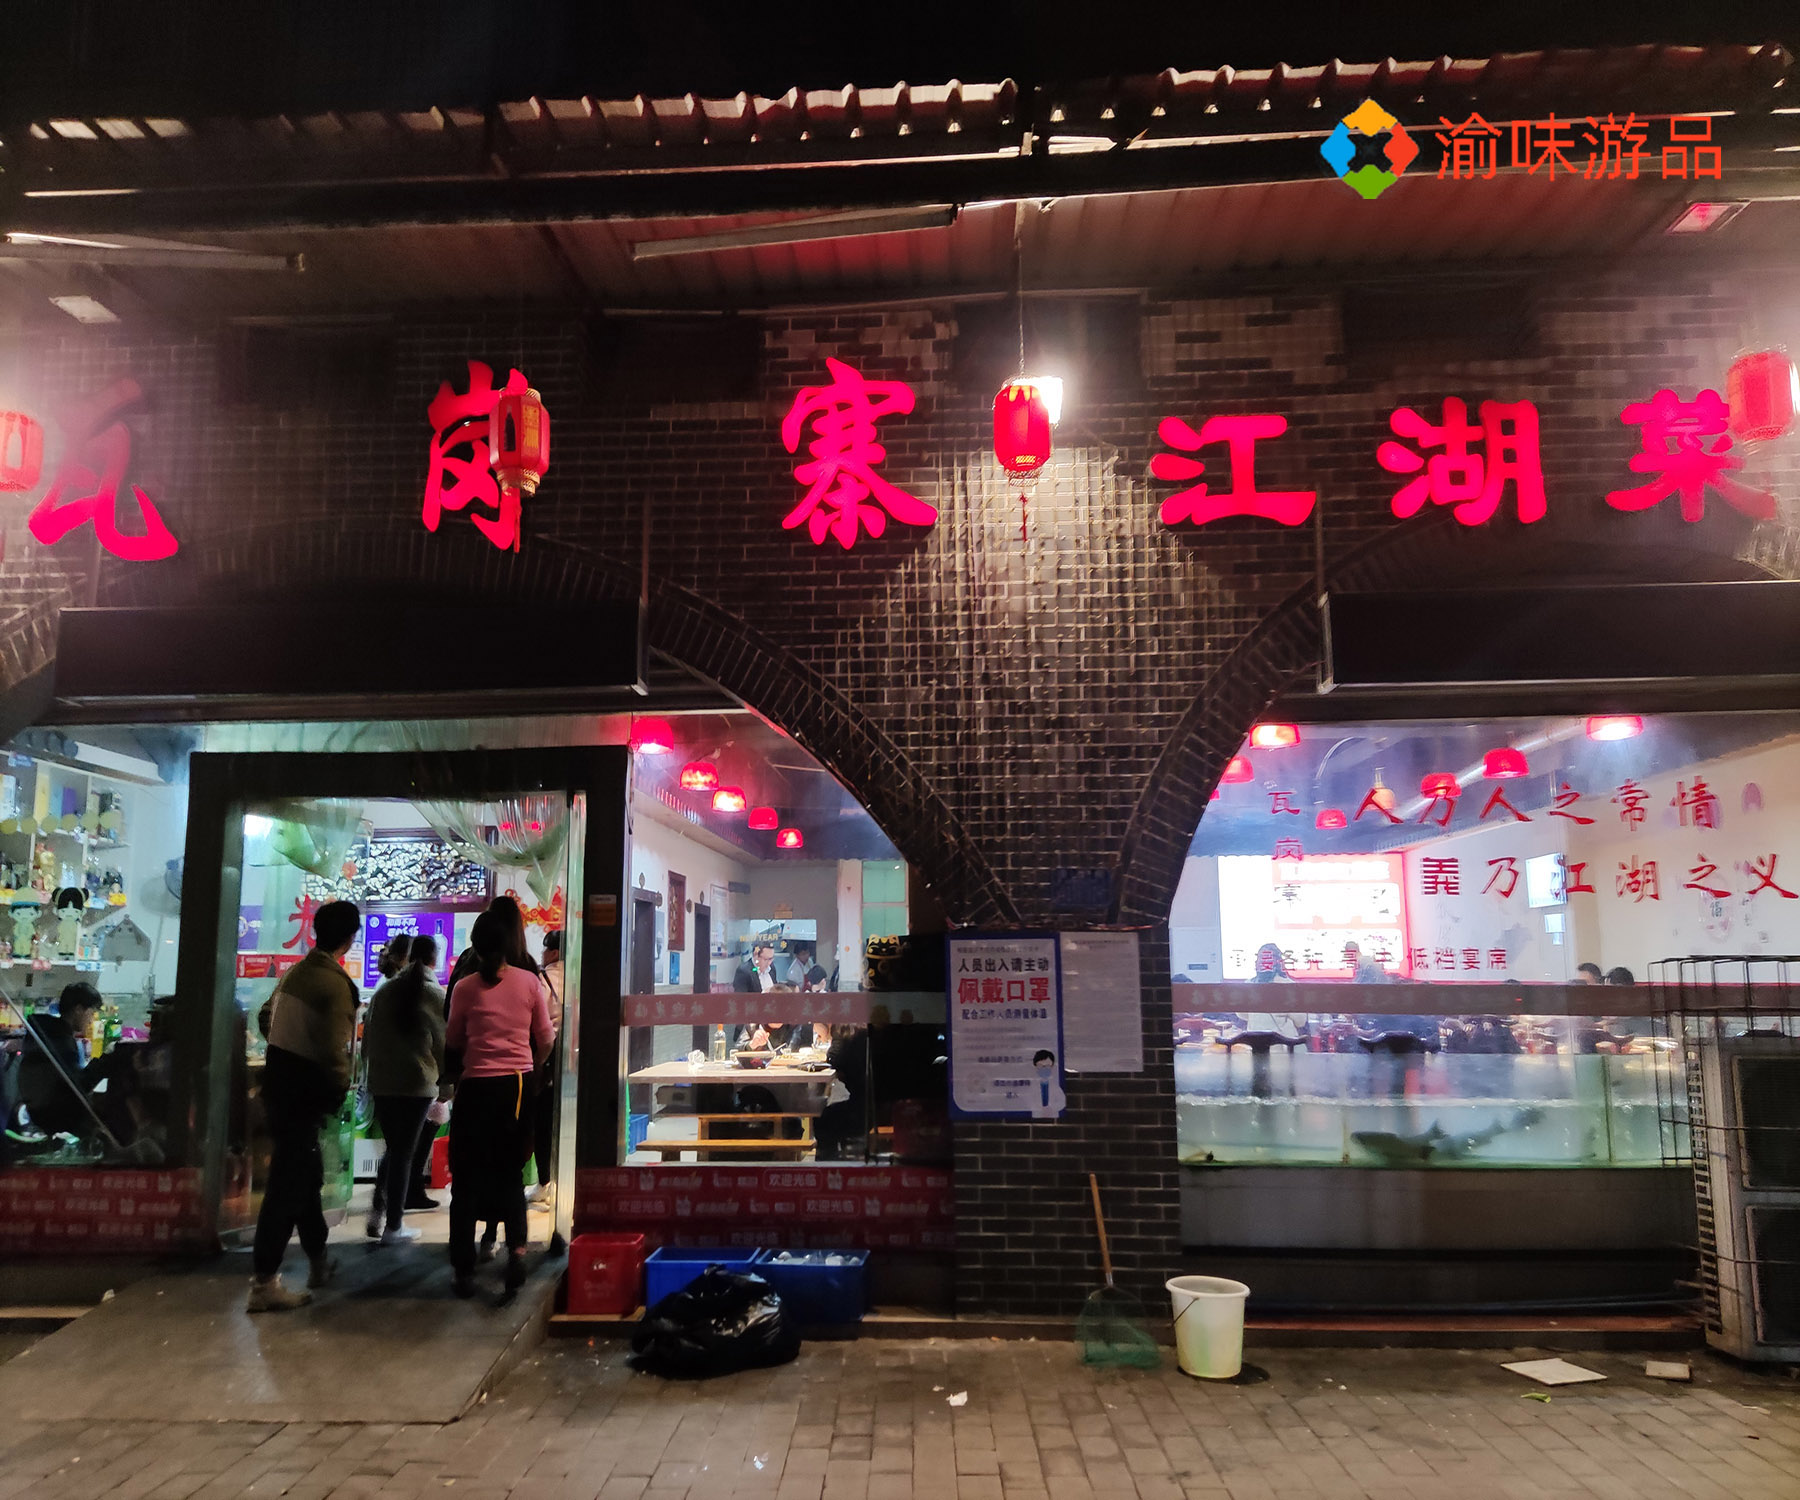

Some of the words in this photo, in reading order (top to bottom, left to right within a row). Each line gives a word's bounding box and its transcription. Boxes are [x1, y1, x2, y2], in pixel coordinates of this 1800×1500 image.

[1353, 777, 1717, 831] 人乃人之常情
[759, 933, 779, 941] YEAR
[958, 957, 1050, 973] 人员出入请主动
[957, 977, 1051, 1005] 佩戴口罩
[961, 1008, 1048, 1020] 配合工作人员测量体温
[769, 1174, 817, 1187] 欢迎光临
[806, 1199, 855, 1213] 欢迎光临
